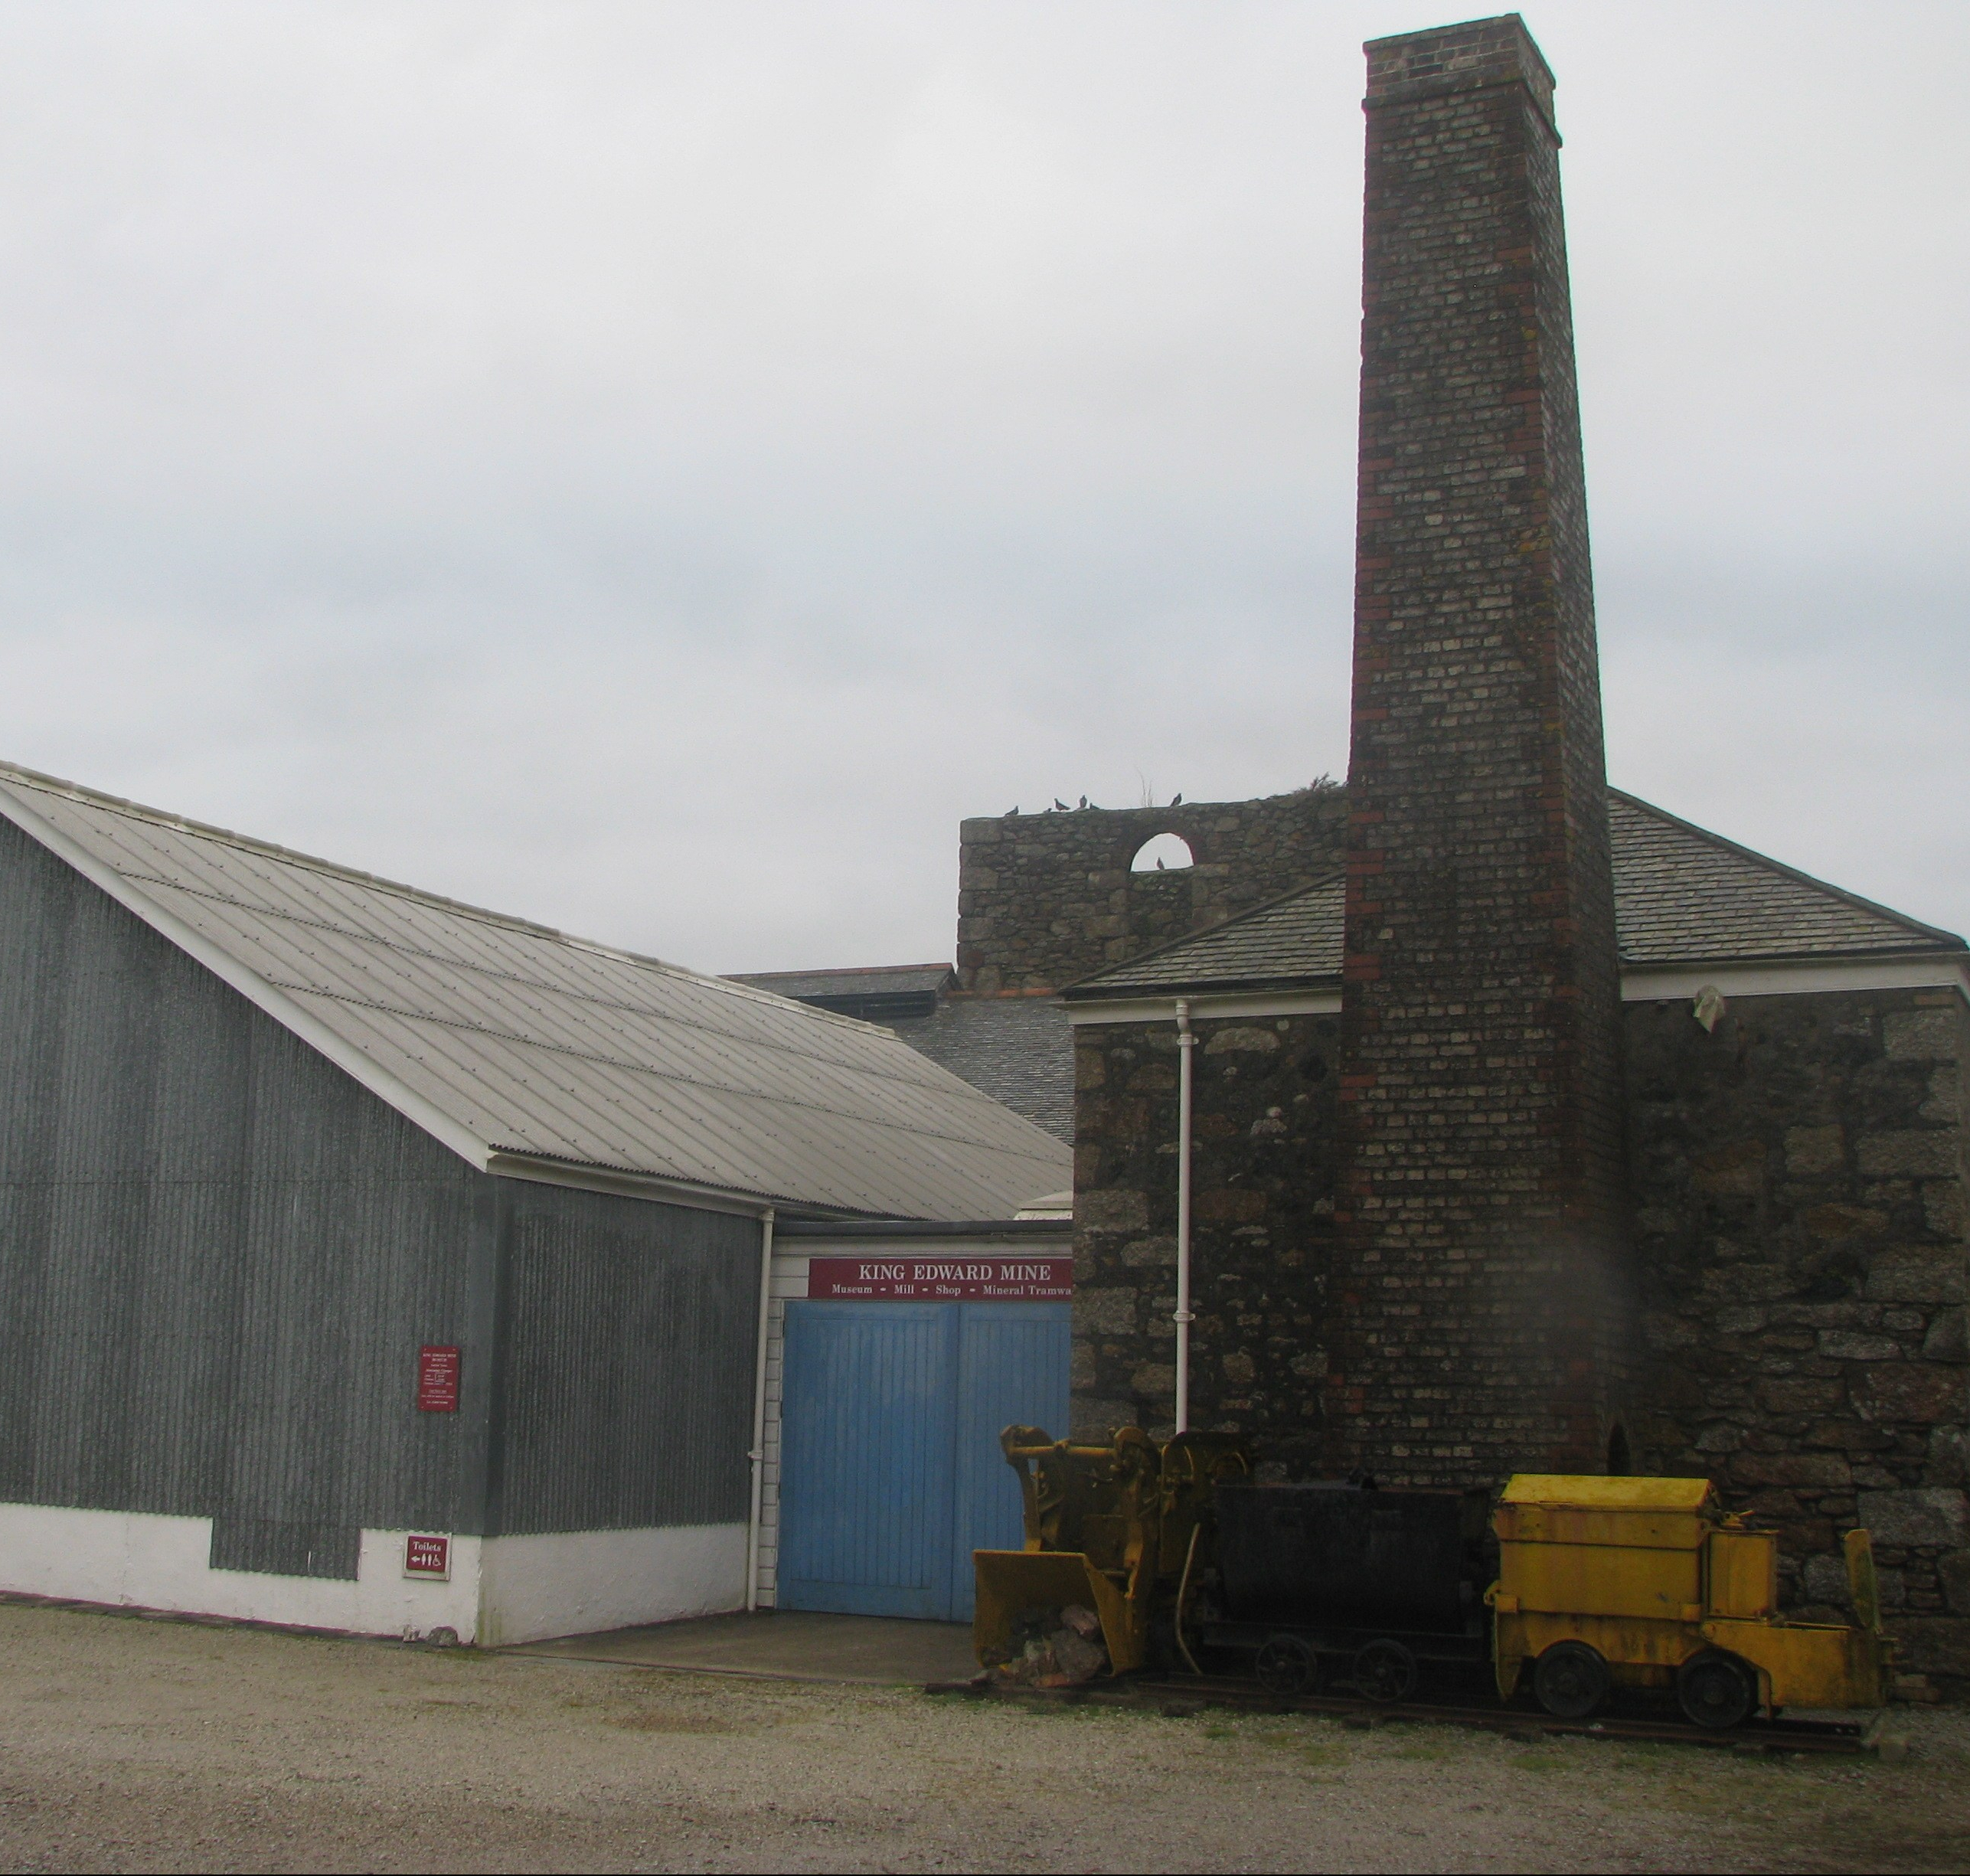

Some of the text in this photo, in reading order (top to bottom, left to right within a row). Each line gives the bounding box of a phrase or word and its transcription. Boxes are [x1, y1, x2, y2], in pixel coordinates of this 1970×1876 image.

[858, 1264, 1051, 1281] KING EDWARD MINE
[831, 1284, 872, 1293] Museum
[894, 1284, 914, 1294] Mill
[936, 1284, 962, 1296] Shop
[983, 1285, 1024, 1296] Mineral
[413, 1541, 441, 1551] Toilets
